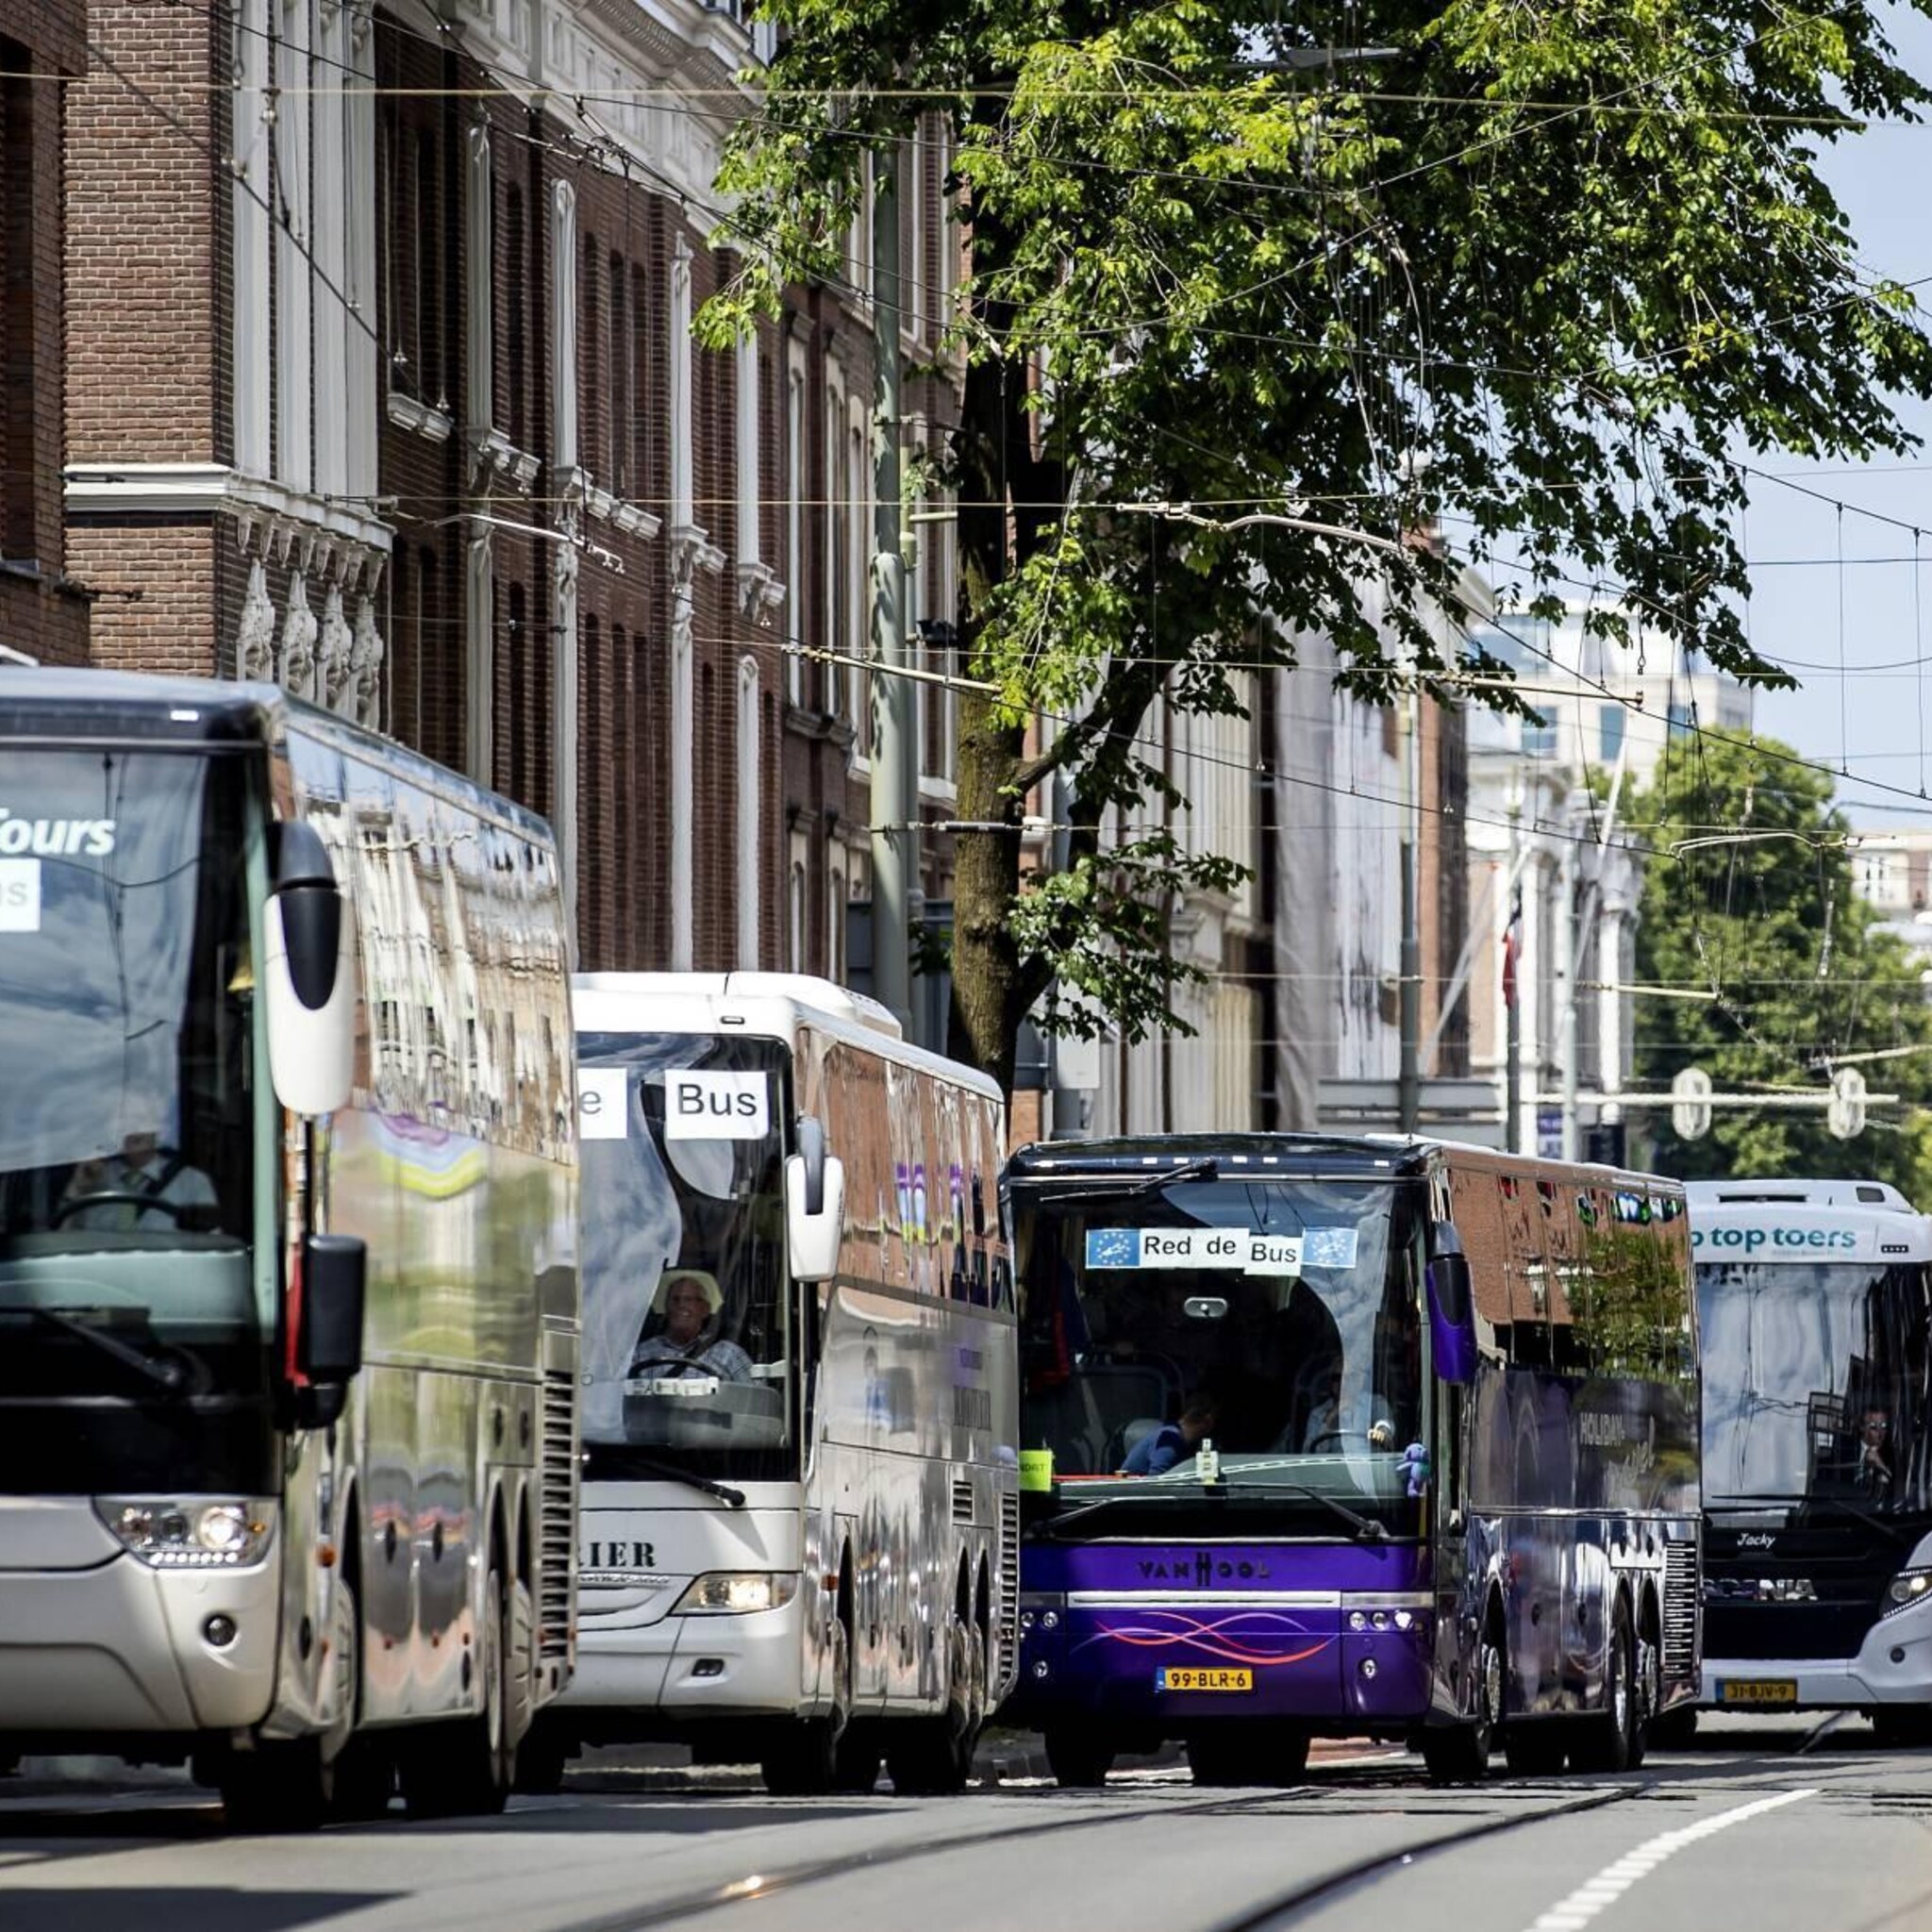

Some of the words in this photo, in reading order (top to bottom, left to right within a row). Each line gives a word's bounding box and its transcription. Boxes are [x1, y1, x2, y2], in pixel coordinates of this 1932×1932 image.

[678, 1084, 758, 1117] Bus
[1144, 1236, 1191, 1256] Red
[1207, 1236, 1237, 1256] de
[1250, 1242, 1297, 1263] Bus
[1710, 1227, 1766, 1253] top
[1773, 1227, 1856, 1248] toers
[1737, 1533, 1776, 1549] Jacky
[1171, 1673, 1246, 1687] 99-BLR-6
